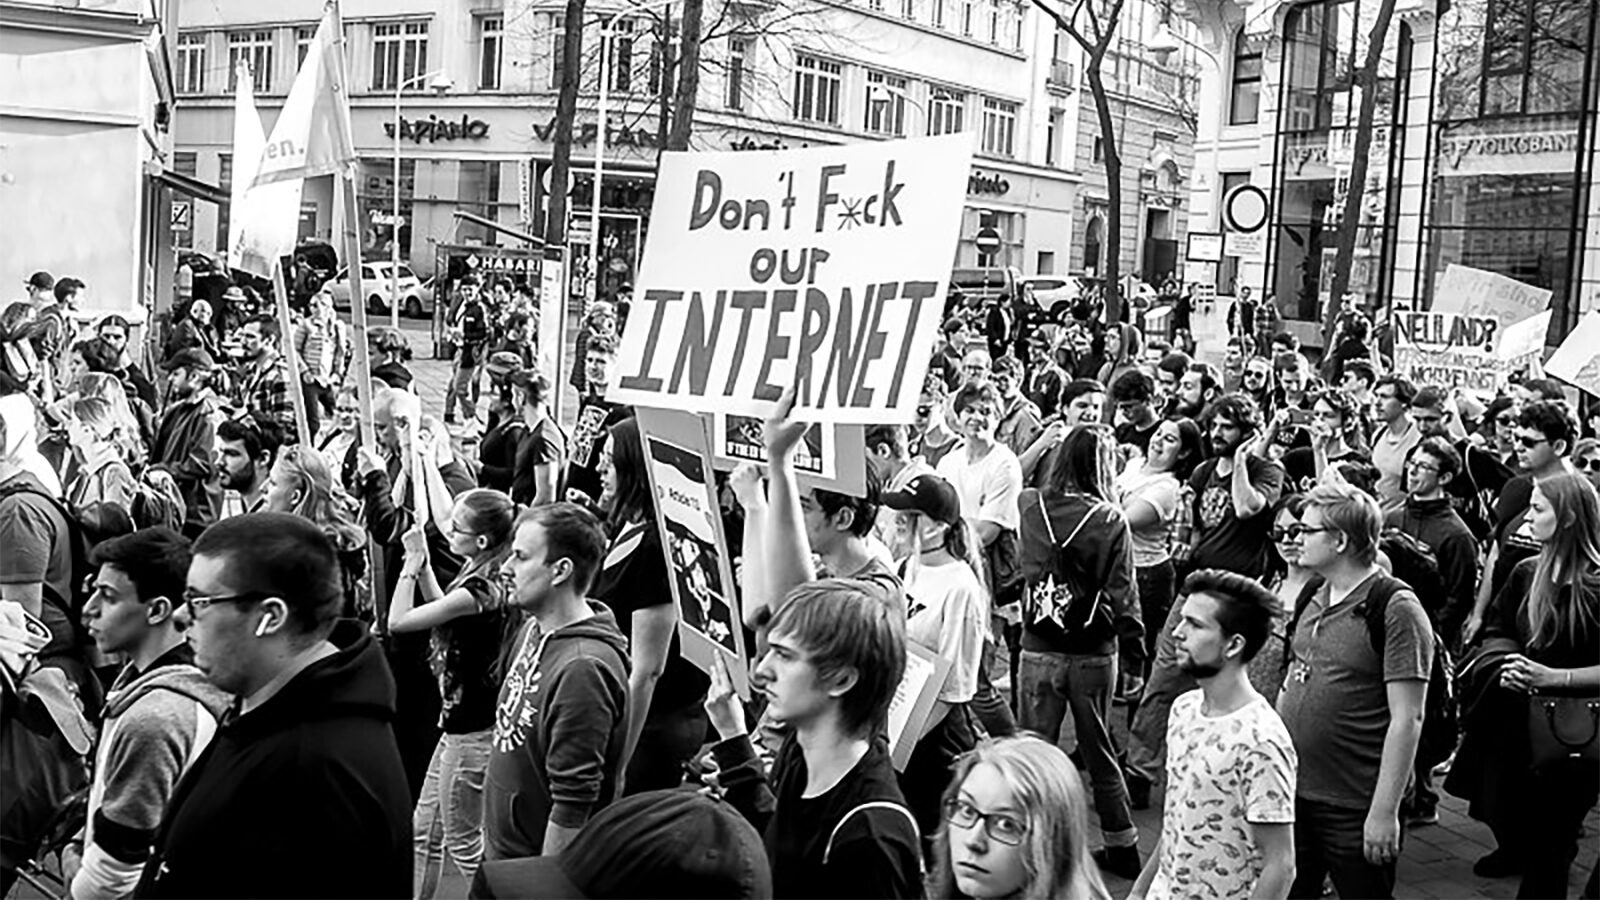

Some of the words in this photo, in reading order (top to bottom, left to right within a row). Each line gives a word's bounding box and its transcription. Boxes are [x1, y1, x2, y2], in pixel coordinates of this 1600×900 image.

[688, 169, 797, 231] Don't
[750, 247, 831, 285] our
[619, 281, 939, 409] INTERNET
